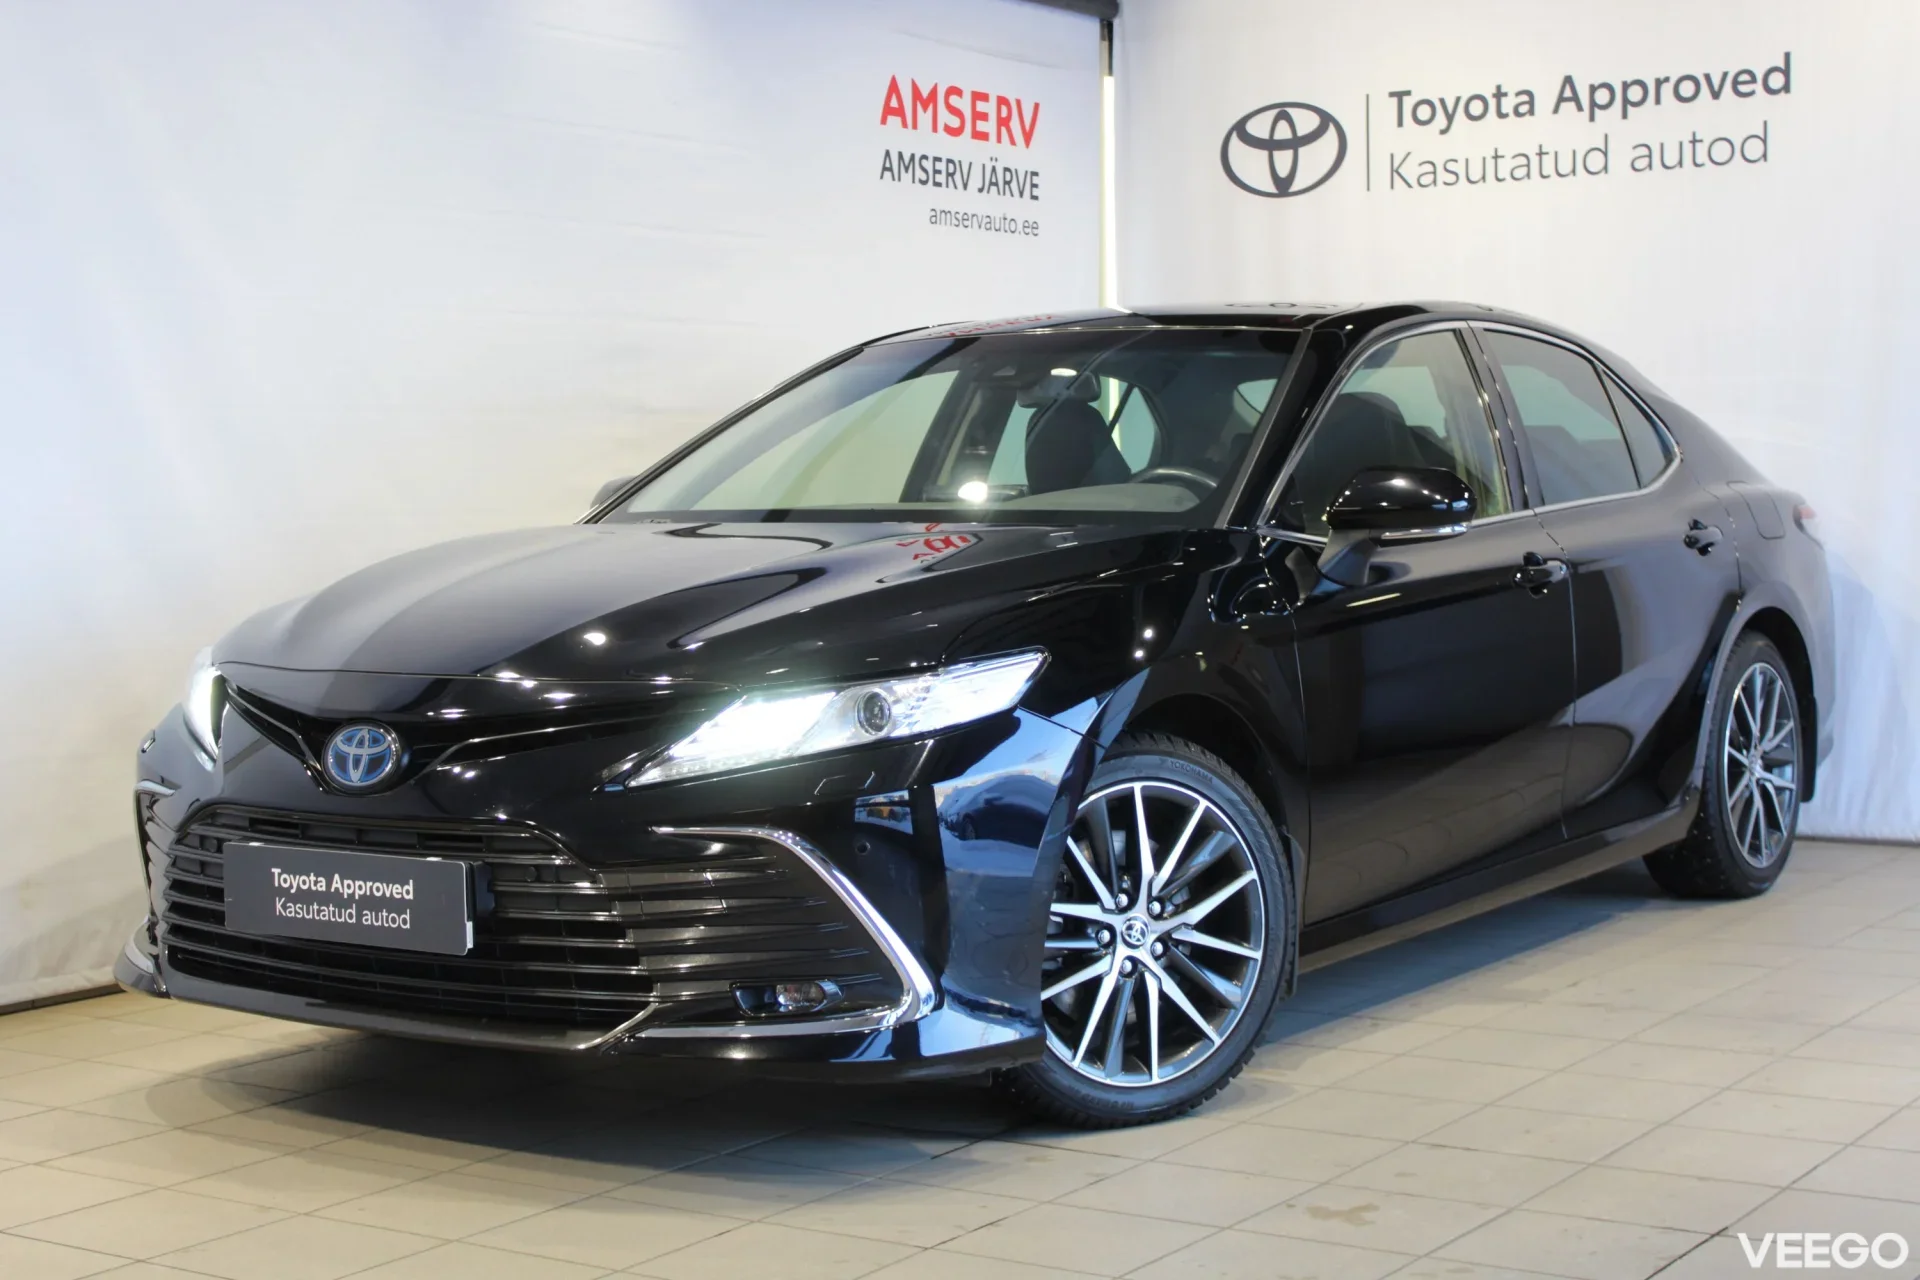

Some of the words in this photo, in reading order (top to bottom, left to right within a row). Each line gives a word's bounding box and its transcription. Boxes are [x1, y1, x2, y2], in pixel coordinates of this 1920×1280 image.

[880, 75, 1040, 149] AMSERV
[1388, 84, 1536, 135] Toyota
[1552, 51, 1793, 123] Approved
[880, 148, 973, 191] AMSERV
[977, 156, 1040, 201] JÄRVE
[1388, 133, 1610, 190] Kasutatud
[1630, 119, 1769, 173] autod
[929, 207, 1040, 237] amservauto.ee
[1170, 759, 1213, 784] YOKOHAMA
[271, 867, 327, 893] Toyota
[330, 872, 414, 900] Approved
[275, 896, 356, 924] Kasutatud
[362, 908, 411, 929] autod
